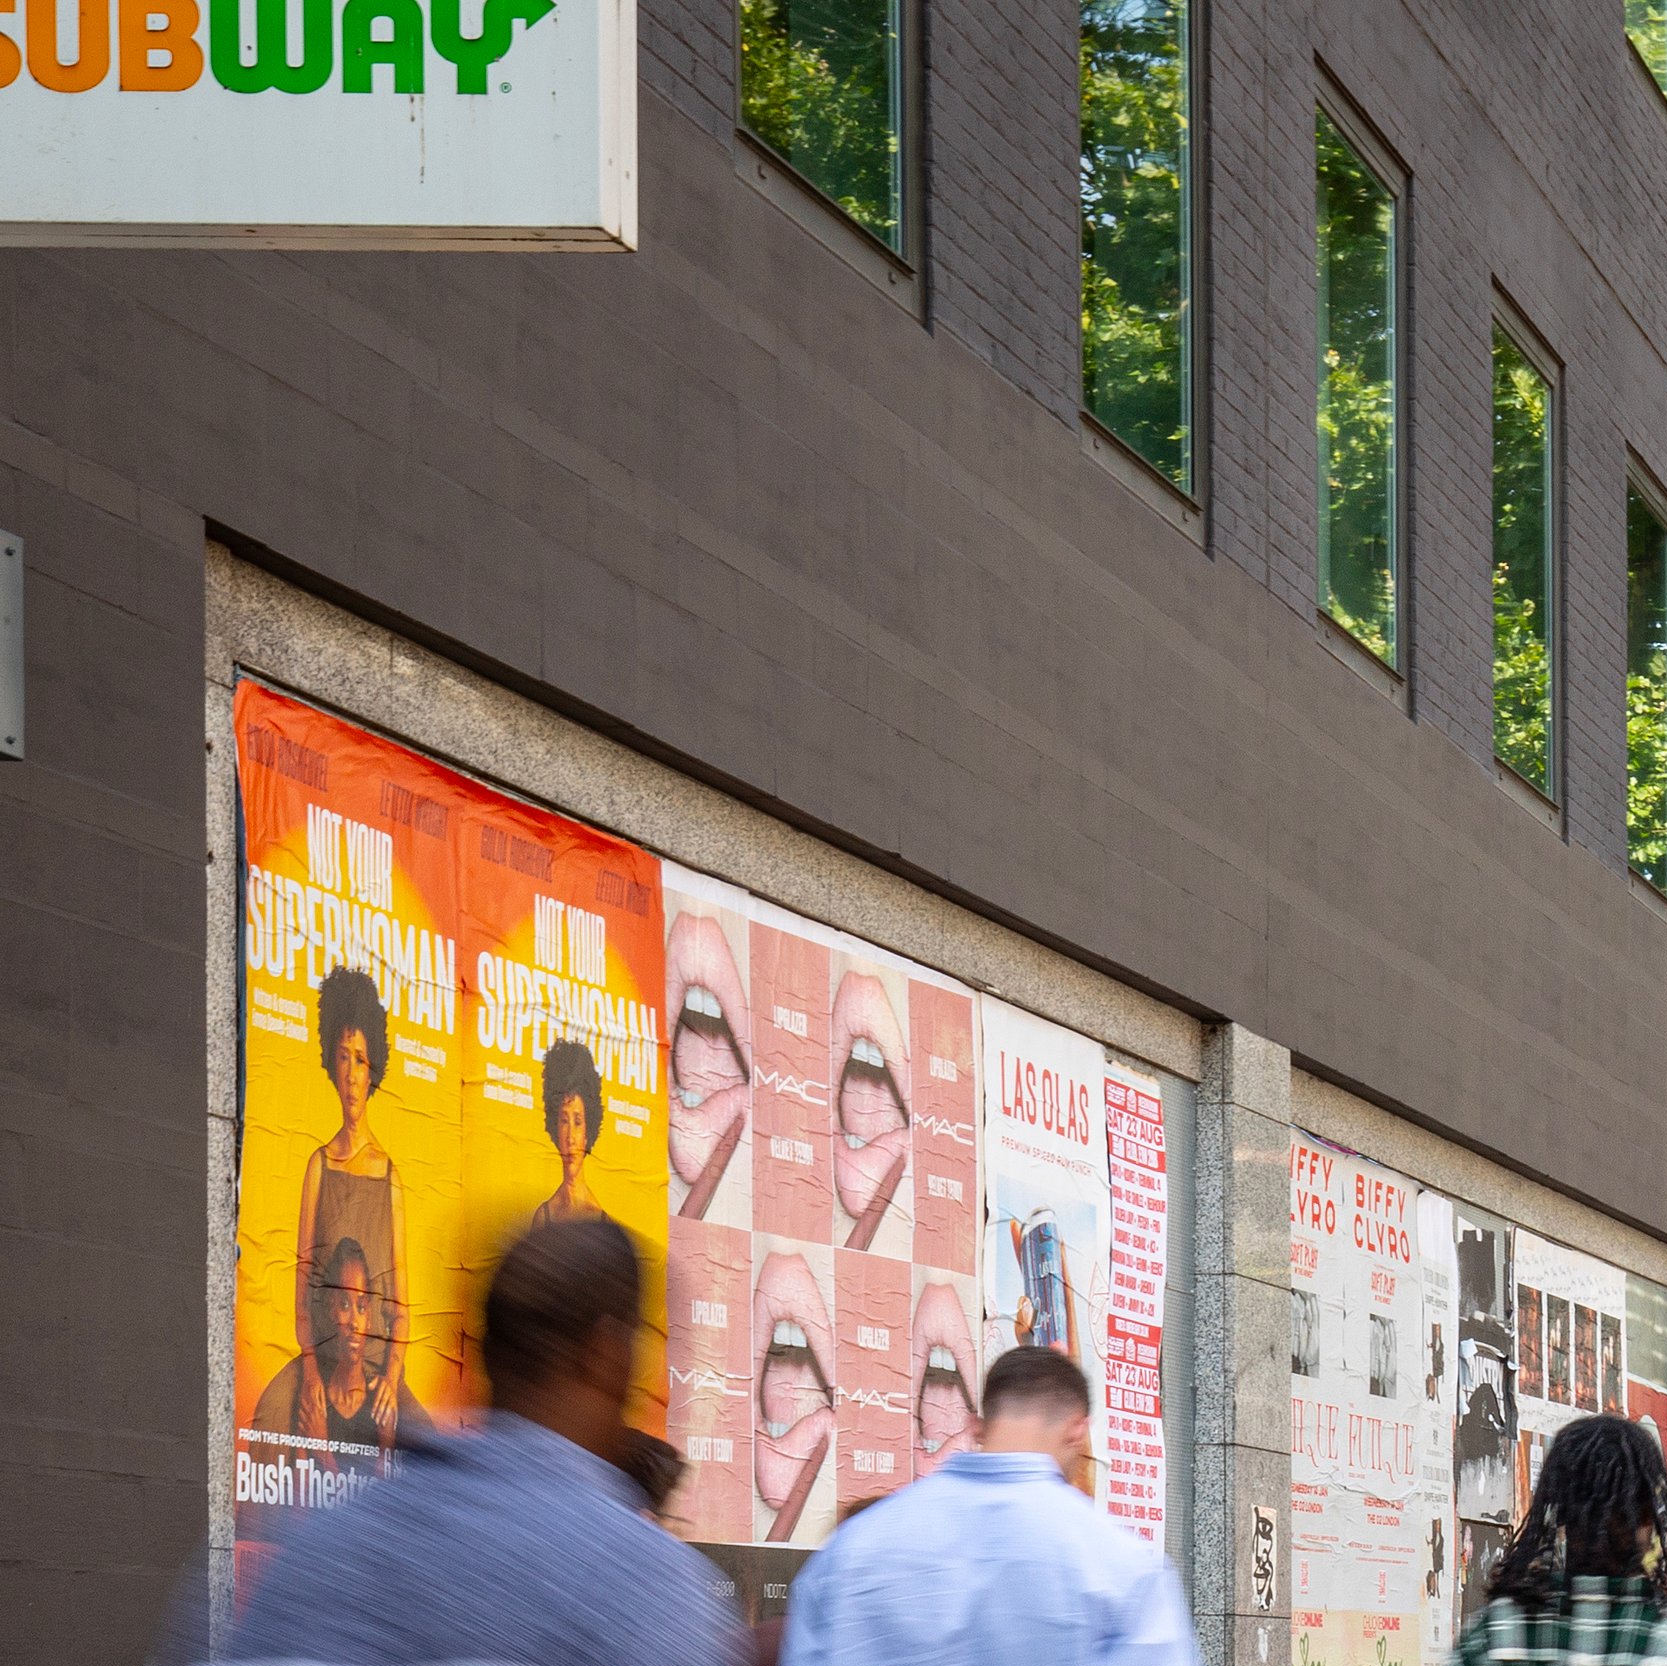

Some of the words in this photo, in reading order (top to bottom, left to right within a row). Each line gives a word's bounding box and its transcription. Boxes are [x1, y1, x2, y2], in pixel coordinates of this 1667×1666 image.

[0, 0, 557, 95] UBWAY
[307, 803, 342, 893] NOT
[346, 819, 393, 912] YOUR
[247, 864, 455, 1035] SUPERWOMAN
[534, 893, 564, 975] NOT
[566, 904, 606, 987] YOUR
[477, 951, 657, 1094] SUPERWOMAN
[1000, 1050, 1037, 1125] LAS
[1042, 1069, 1089, 1146] OLAS
[1107, 1106, 1123, 1133] SAT
[1126, 1115, 1137, 1139] 23
[1140, 1121, 1164, 1147] AUG
[1290, 1143, 1333, 1192] IFFY
[1290, 1189, 1336, 1235] YRO
[1356, 1173, 1406, 1223] BIFFY
[1354, 1213, 1410, 1264] CLYRO
[1105, 1360, 1122, 1384] SAT
[1125, 1366, 1136, 1387] 23
[1138, 1369, 1159, 1392] AUG
[238, 1428, 261, 1443] FROM
[263, 1431, 278, 1445] THE
[279, 1434, 328, 1452] PRODUCERS
[329, 1440, 340, 1453] OF
[340, 1441, 380, 1458] SHIFTERS
[236, 1451, 293, 1507] Bush
